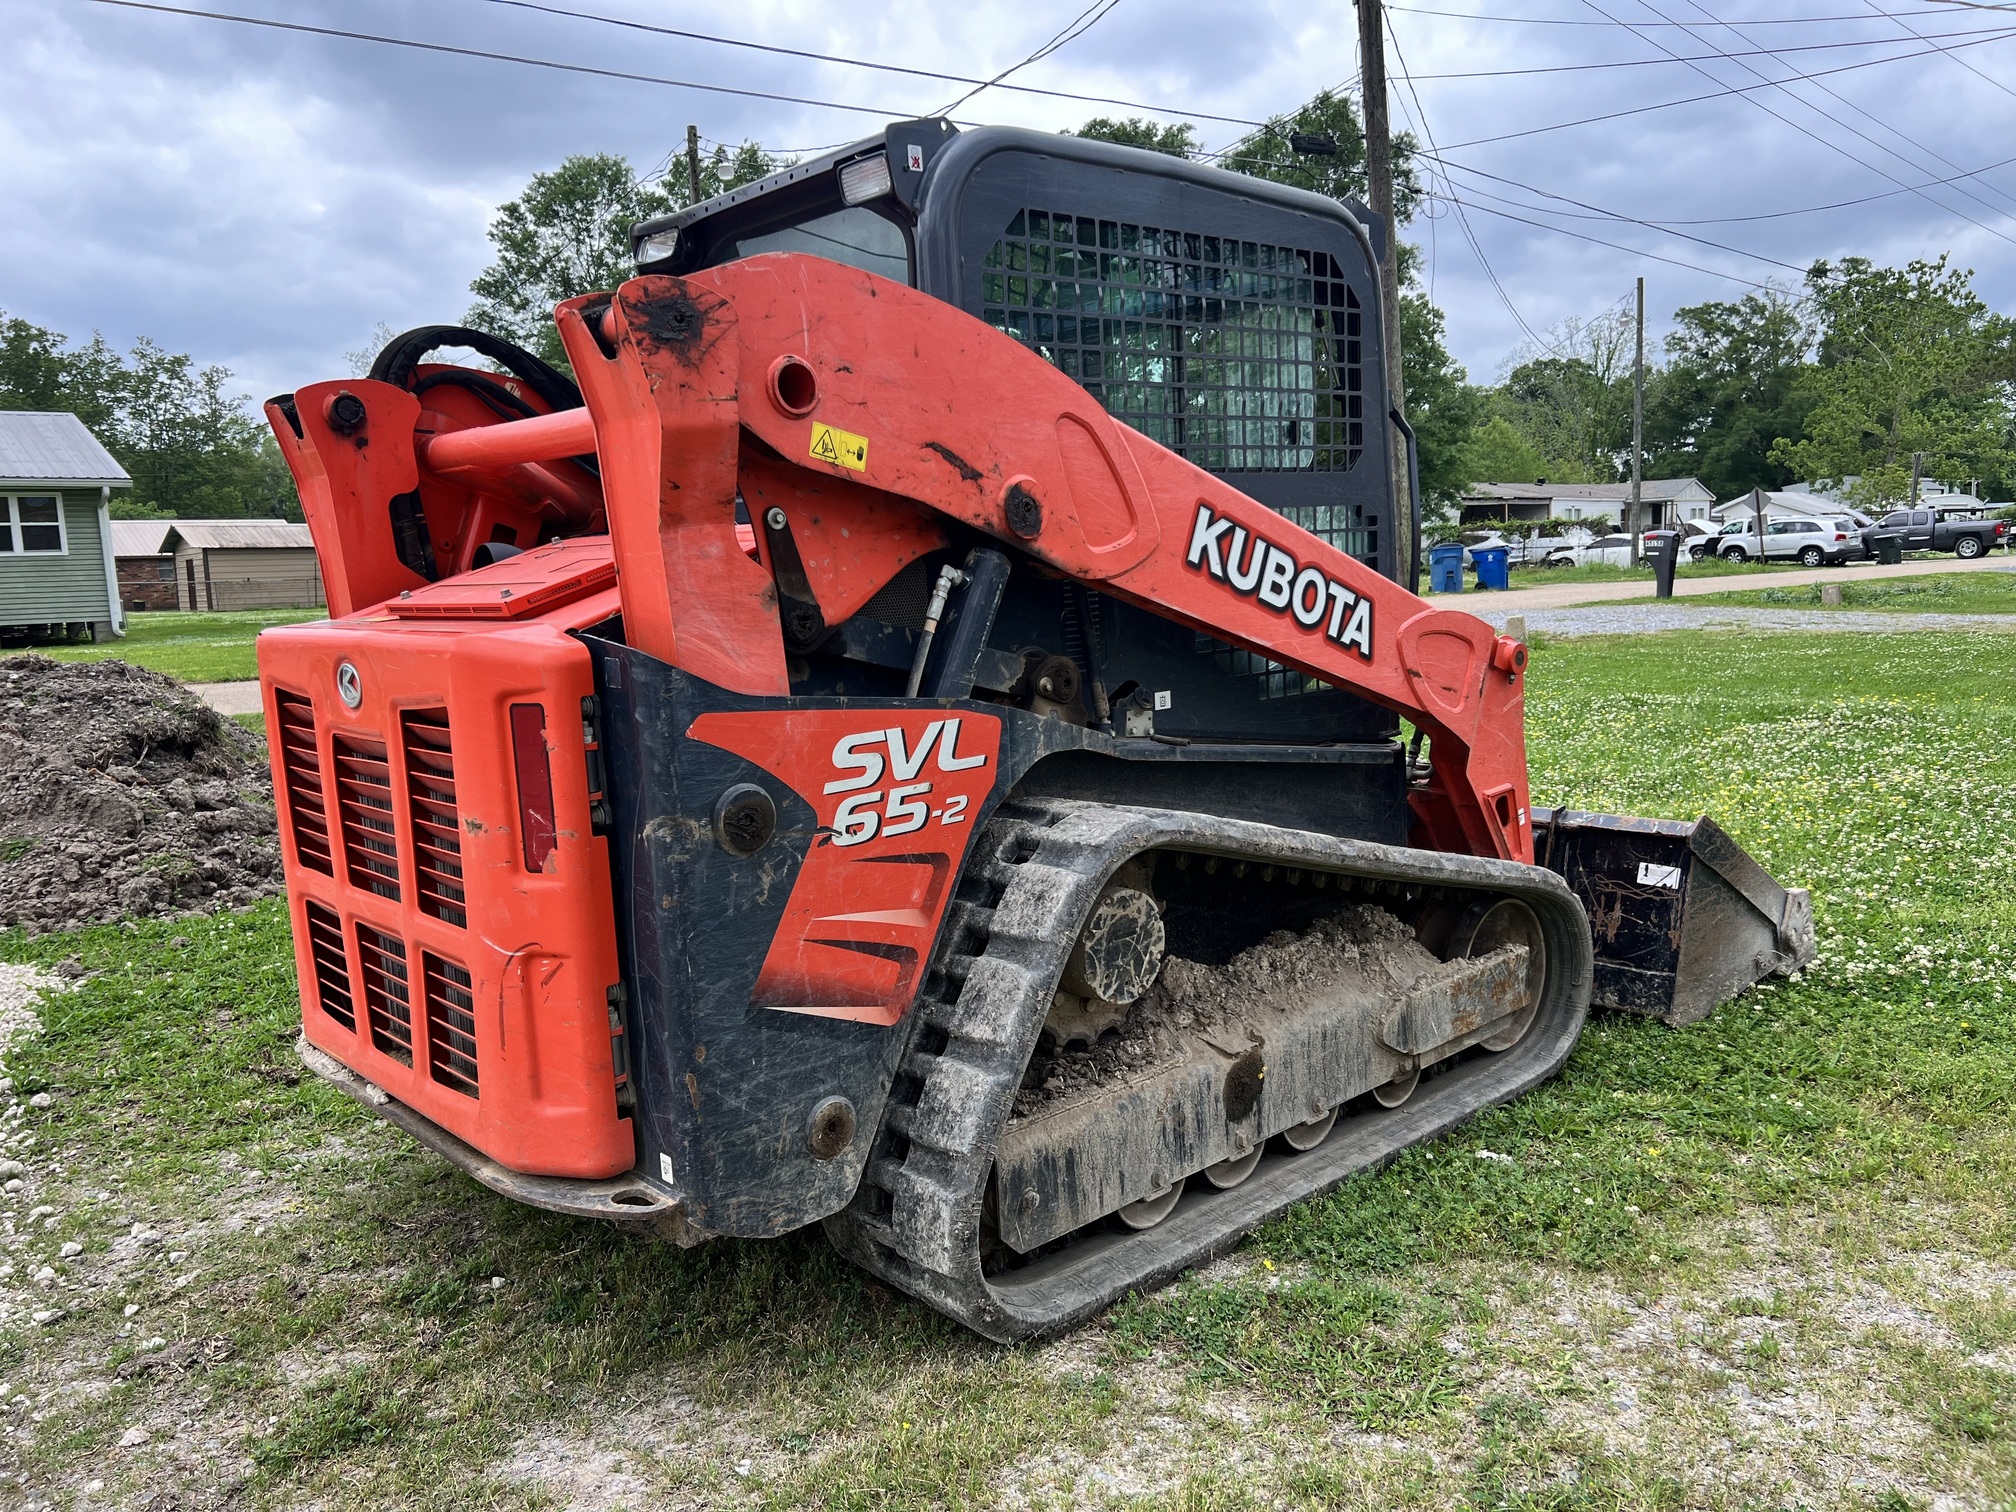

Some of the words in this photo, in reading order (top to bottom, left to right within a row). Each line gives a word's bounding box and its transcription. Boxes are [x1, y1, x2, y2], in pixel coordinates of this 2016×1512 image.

[1186, 504, 1371, 657] KUBOTA
[822, 717, 987, 794] SVL
[832, 781, 969, 848] 65-2
